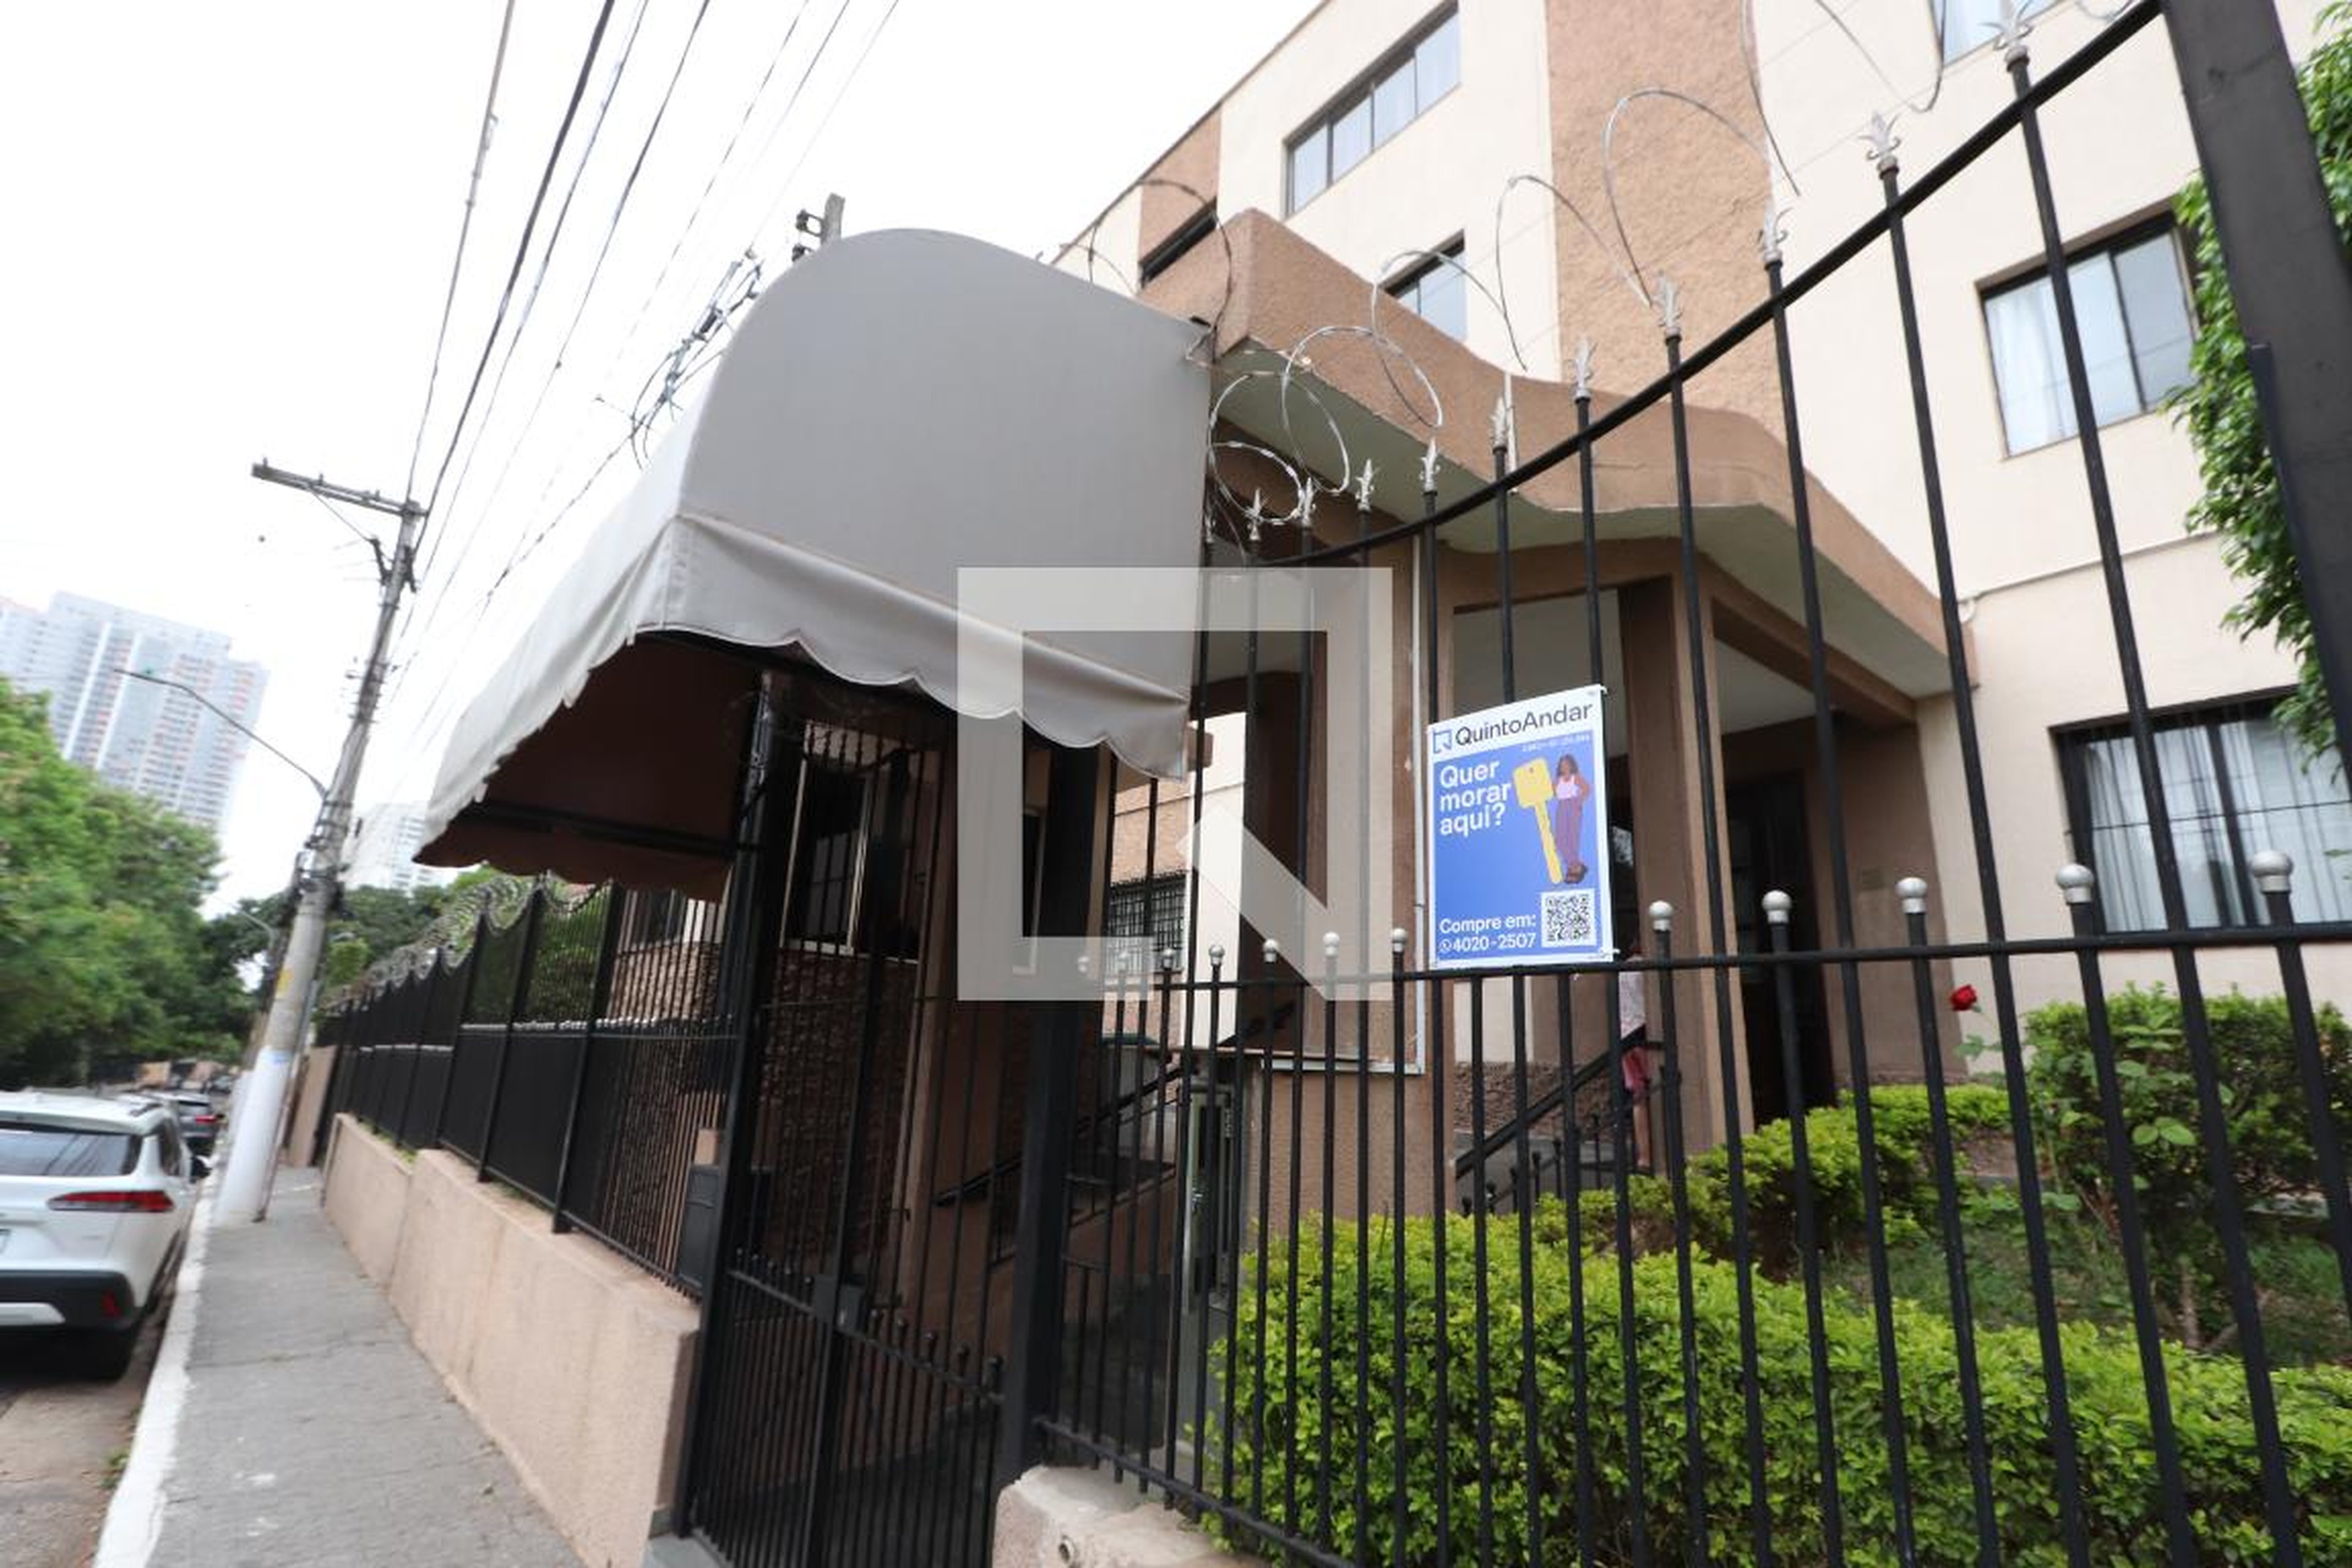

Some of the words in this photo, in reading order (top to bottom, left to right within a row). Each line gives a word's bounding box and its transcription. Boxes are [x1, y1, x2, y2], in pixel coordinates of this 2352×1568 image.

[1455, 704, 1593, 746] QuintoAndar
[1440, 761, 1499, 788] Quer
[1440, 783, 1511, 812] morar
[1440, 802, 1506, 837] aqui?
[1439, 918, 1501, 935] Compre
[1505, 914, 1536, 929] em:
